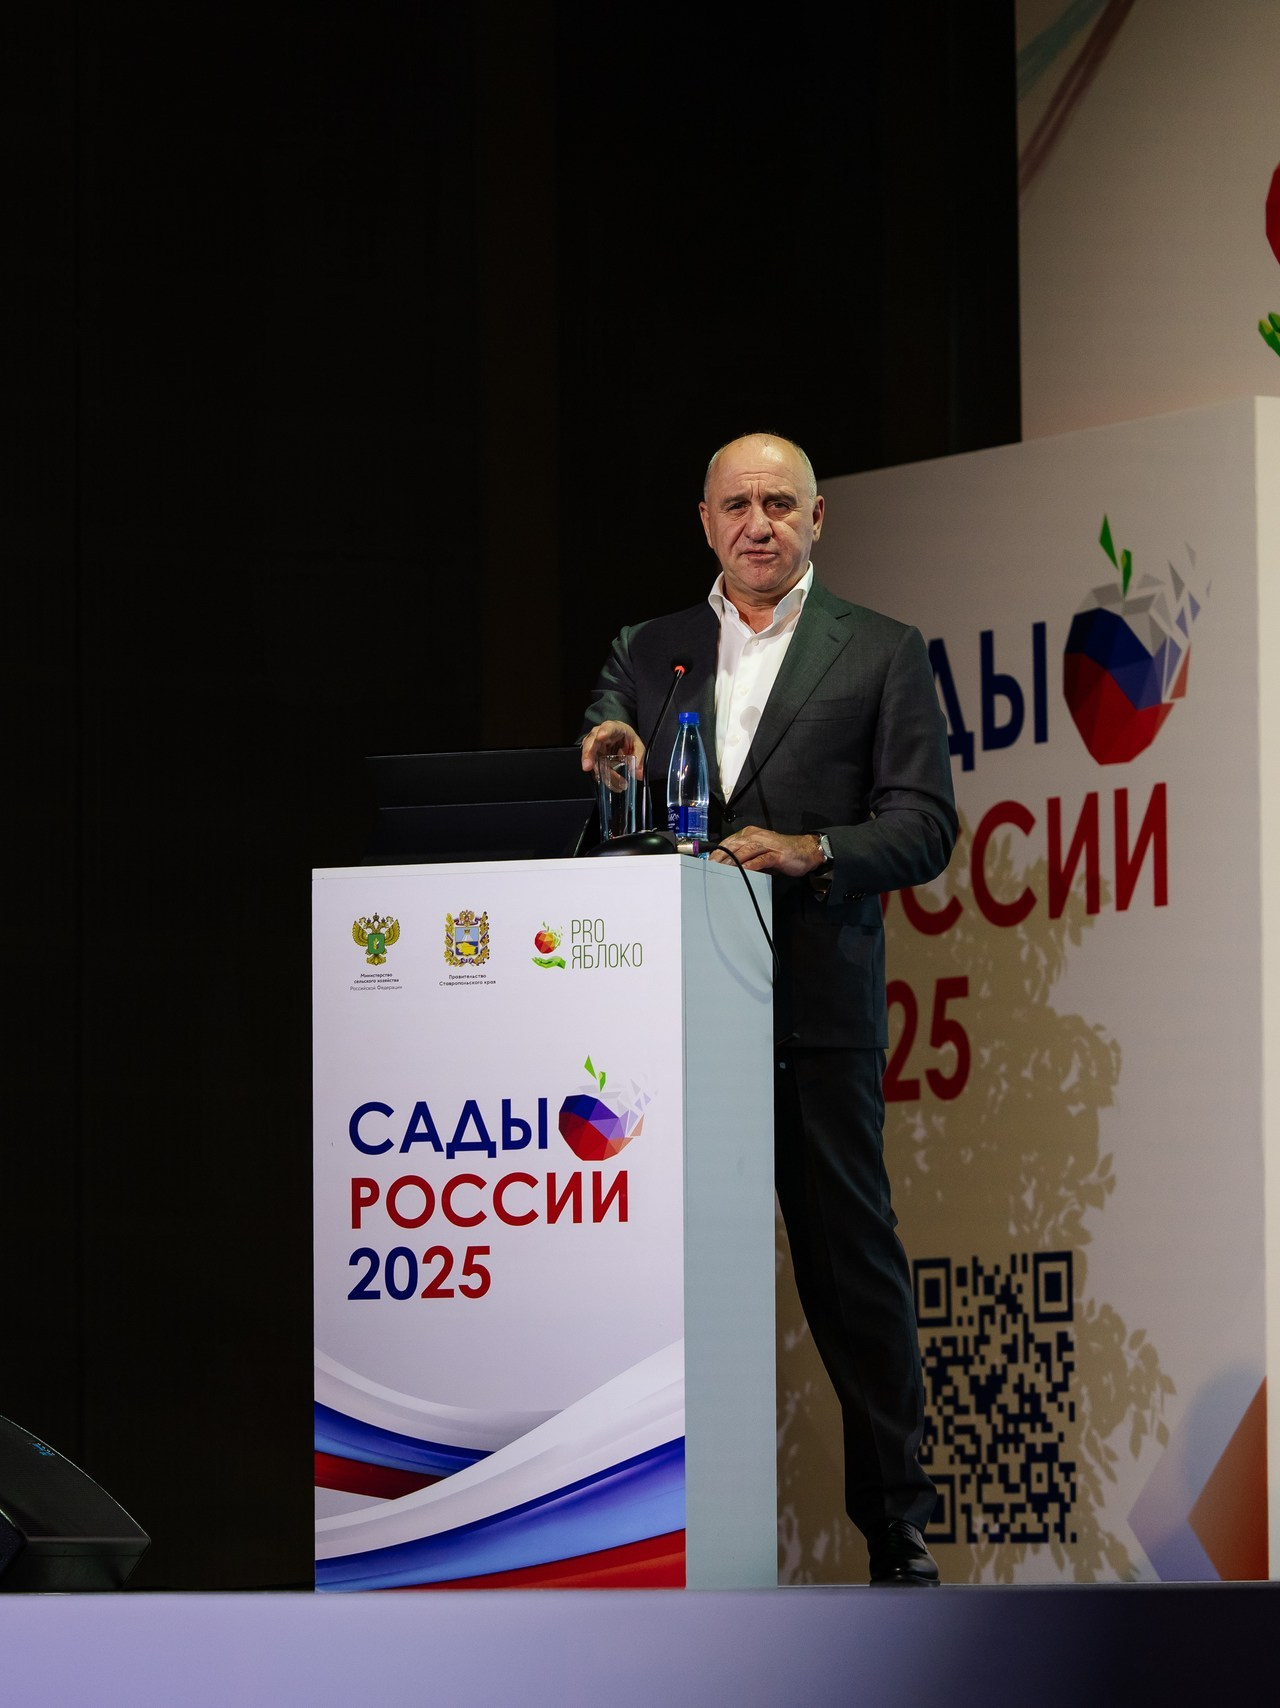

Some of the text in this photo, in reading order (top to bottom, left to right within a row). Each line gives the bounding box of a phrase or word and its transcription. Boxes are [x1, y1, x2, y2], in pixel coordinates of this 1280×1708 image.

[928, 622, 1049, 772] ДЫ
[571, 918, 605, 944] PRO
[571, 942, 643, 970] ЯБЛОКО
[881, 975, 971, 1103] 25
[348, 1097, 549, 1160] САДЫ
[350, 1169, 629, 1230] РОССИИ
[347, 1244, 492, 1301] 2025
